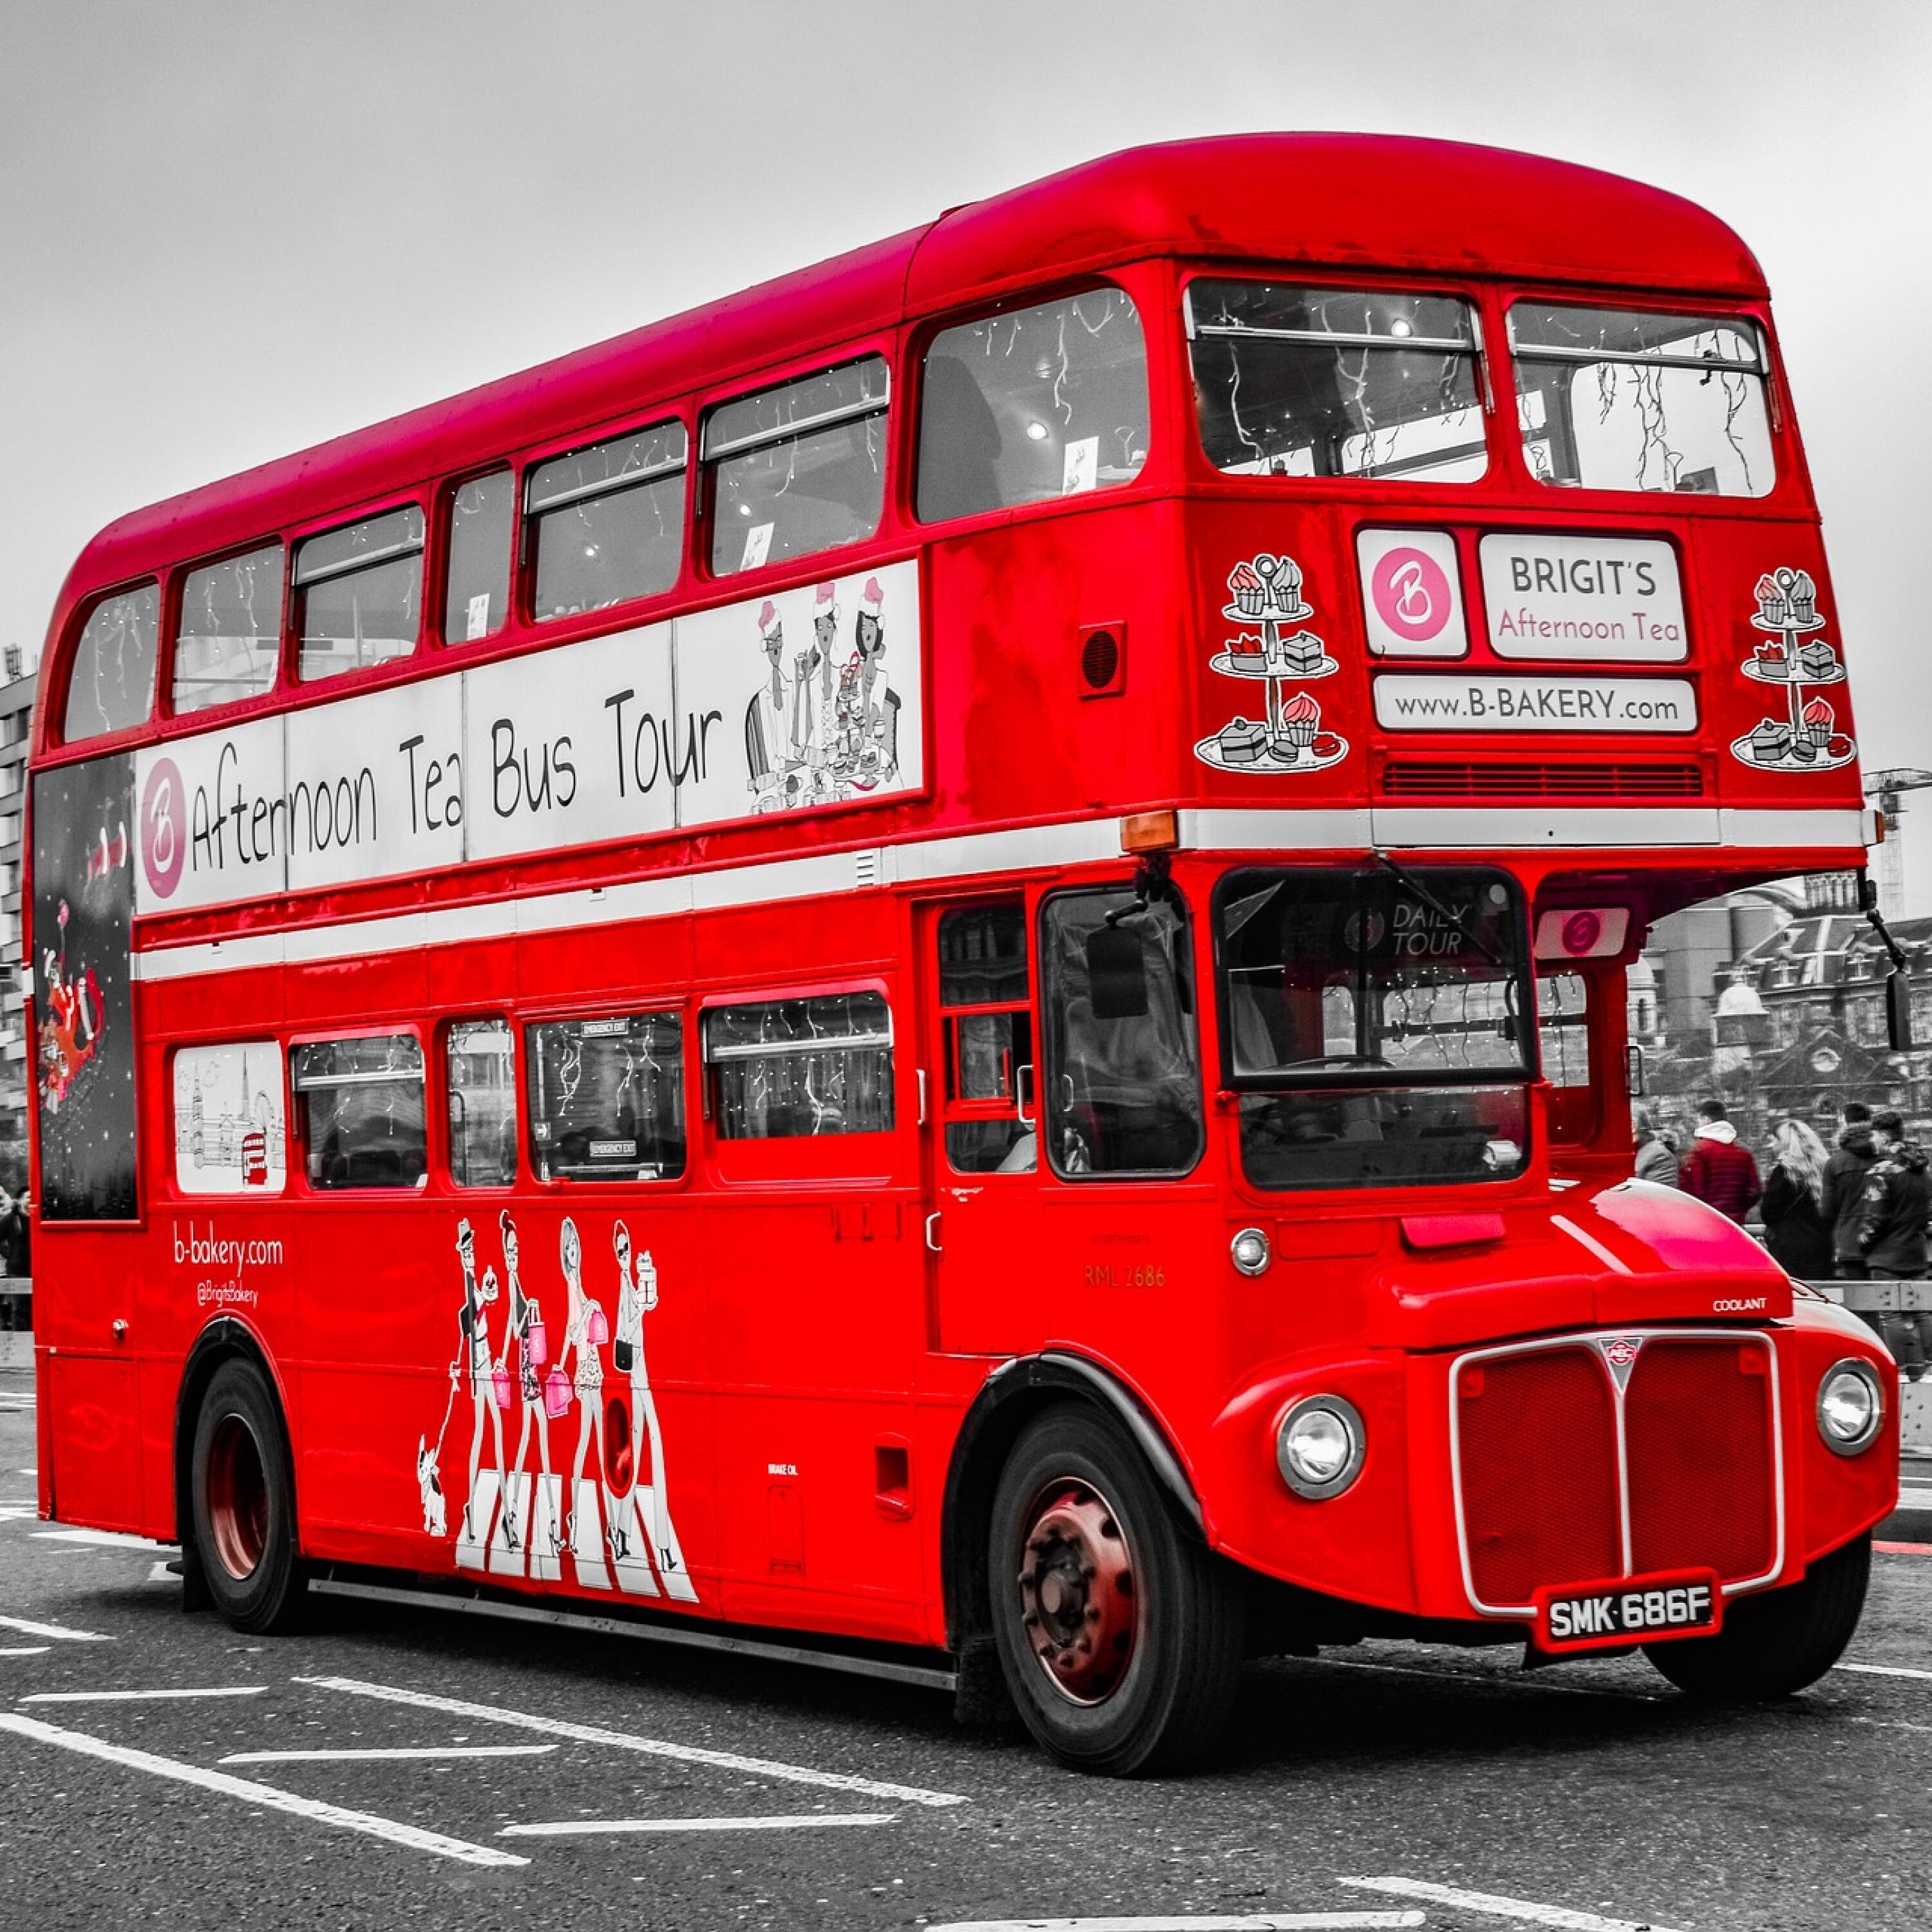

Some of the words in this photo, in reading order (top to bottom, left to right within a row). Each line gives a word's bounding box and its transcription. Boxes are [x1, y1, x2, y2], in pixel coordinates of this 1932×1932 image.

[1389, 560, 1432, 625] B
[1510, 556, 1656, 596] BRIGIT'S
[1498, 607, 1625, 640] Afternoon
[1632, 612, 1680, 641] Tea
[1395, 688, 1679, 720] www.B-BAKERY.com
[193, 742, 377, 872] Afternoon
[399, 734, 462, 834] Tea
[491, 717, 576, 818] Bus
[605, 689, 723, 798] Tour
[1392, 904, 1473, 928] DAILY
[1392, 932, 1462, 955] TOUR
[173, 1220, 283, 1278] b-bakery.com
[1084, 1265, 1119, 1287] RML
[1125, 1265, 1165, 1287] 2686
[1712, 1297, 1767, 1312] COOLANT
[1550, 1596, 1615, 1636] SMK
[1621, 1586, 1711, 1628] 686F
